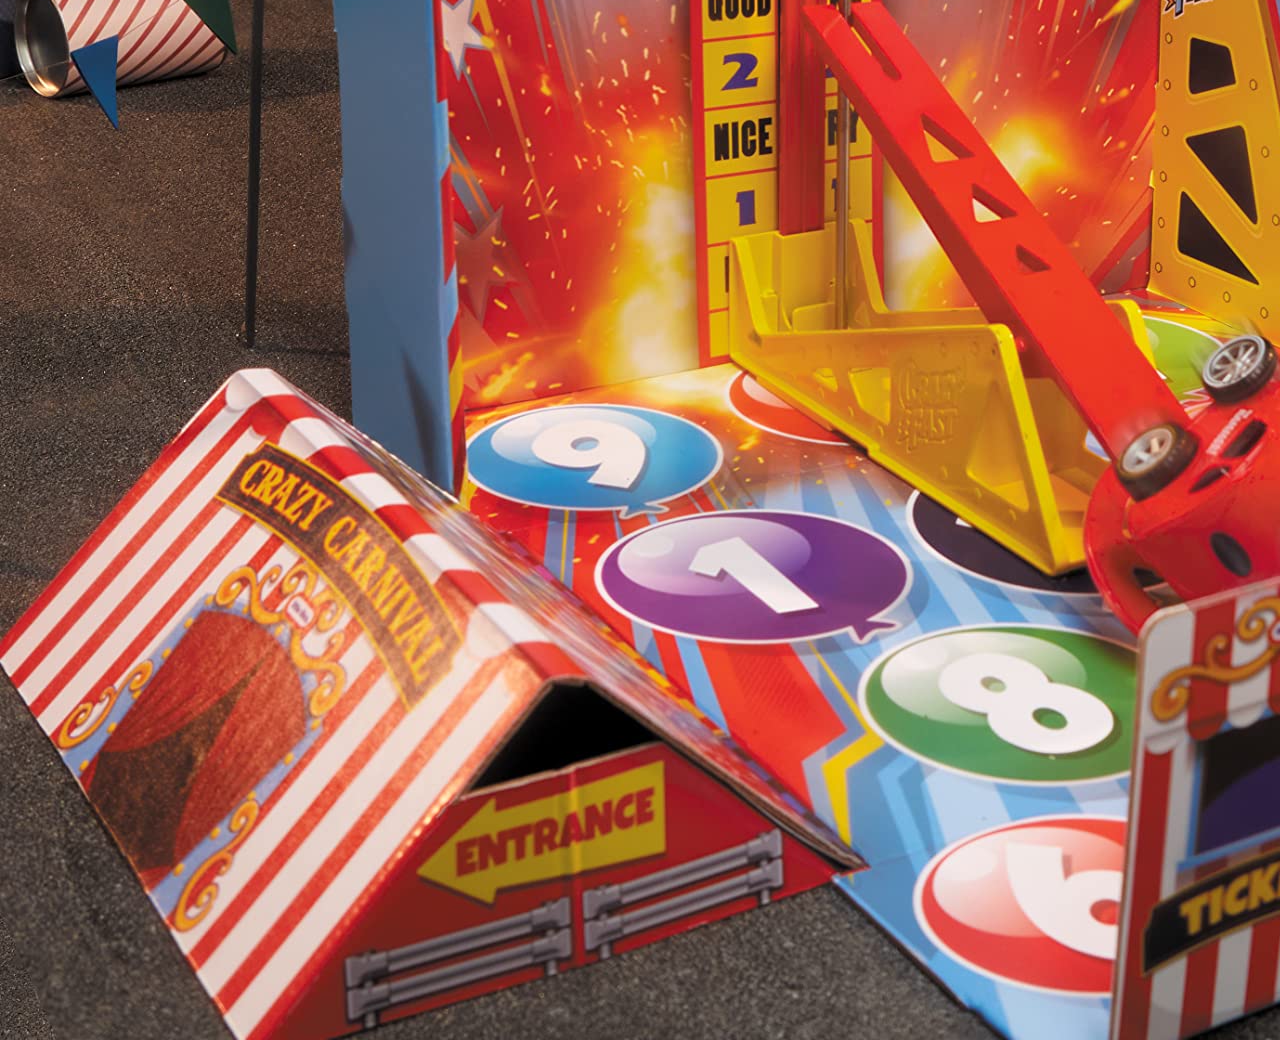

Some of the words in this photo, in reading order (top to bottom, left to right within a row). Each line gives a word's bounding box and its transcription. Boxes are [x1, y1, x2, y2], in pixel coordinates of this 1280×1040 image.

[721, 52, 759, 91] 2
[713, 117, 773, 161] NICE
[735, 189, 756, 226] 1
[531, 418, 647, 490] 9
[238, 459, 334, 531] CRAZY
[323, 516, 444, 686] CARNIVAL
[687, 536, 820, 615] 1
[937, 652, 1115, 755] 8
[455, 786, 656, 878] ENTRANCE
